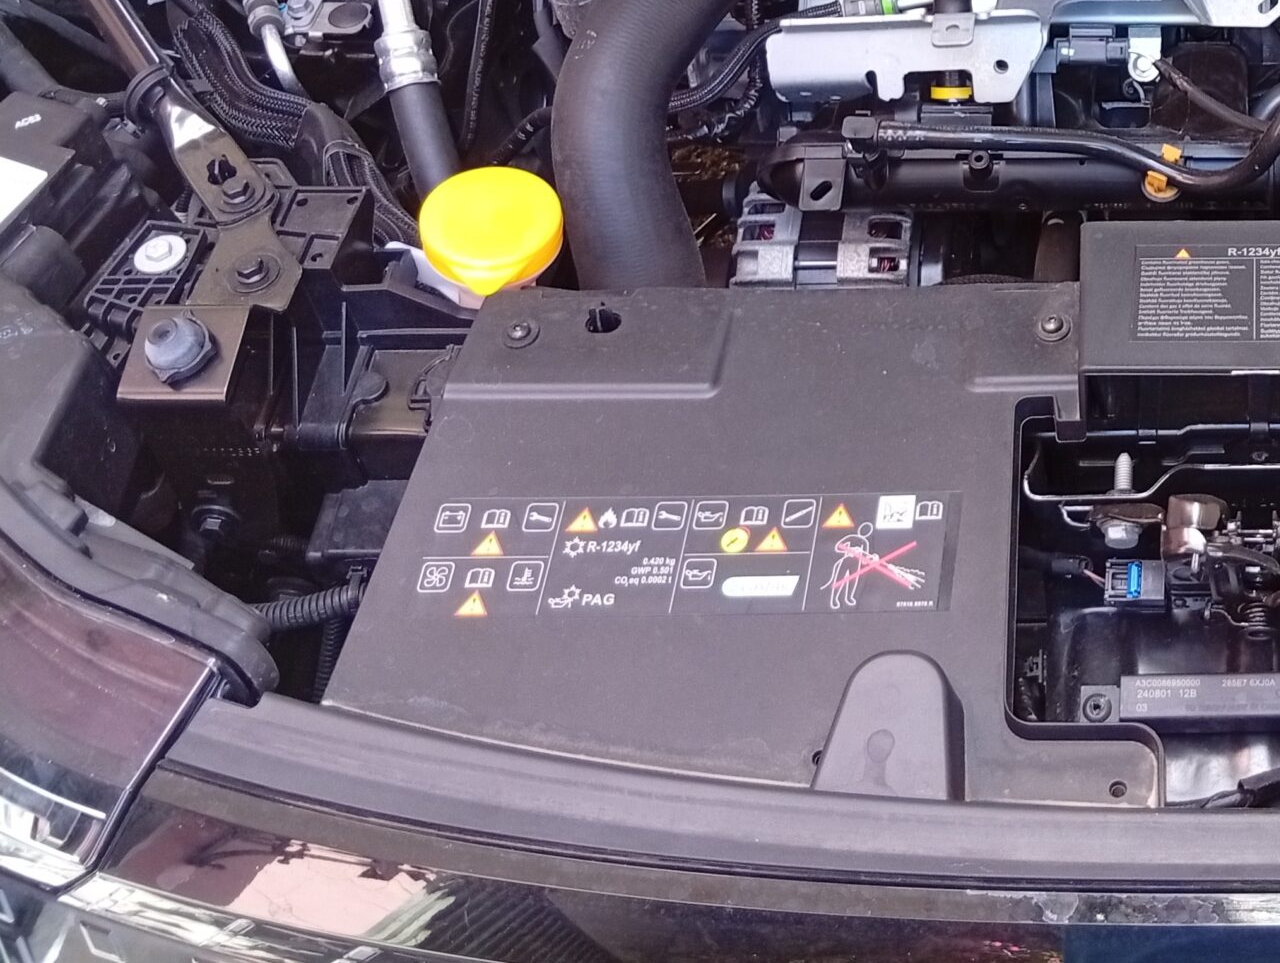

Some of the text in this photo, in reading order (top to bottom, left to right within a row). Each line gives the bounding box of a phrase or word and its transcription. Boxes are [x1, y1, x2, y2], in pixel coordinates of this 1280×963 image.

[586, 539, 642, 555] R-1234yf
[642, 557, 676, 566] 0.420 kg
[631, 566, 674, 575] GWP 0.501
[640, 575, 667, 584] 0.0002
[581, 593, 616, 606] PAG
[1136, 688, 1197, 699] 240801 12B
[1135, 702, 1148, 713] 03
